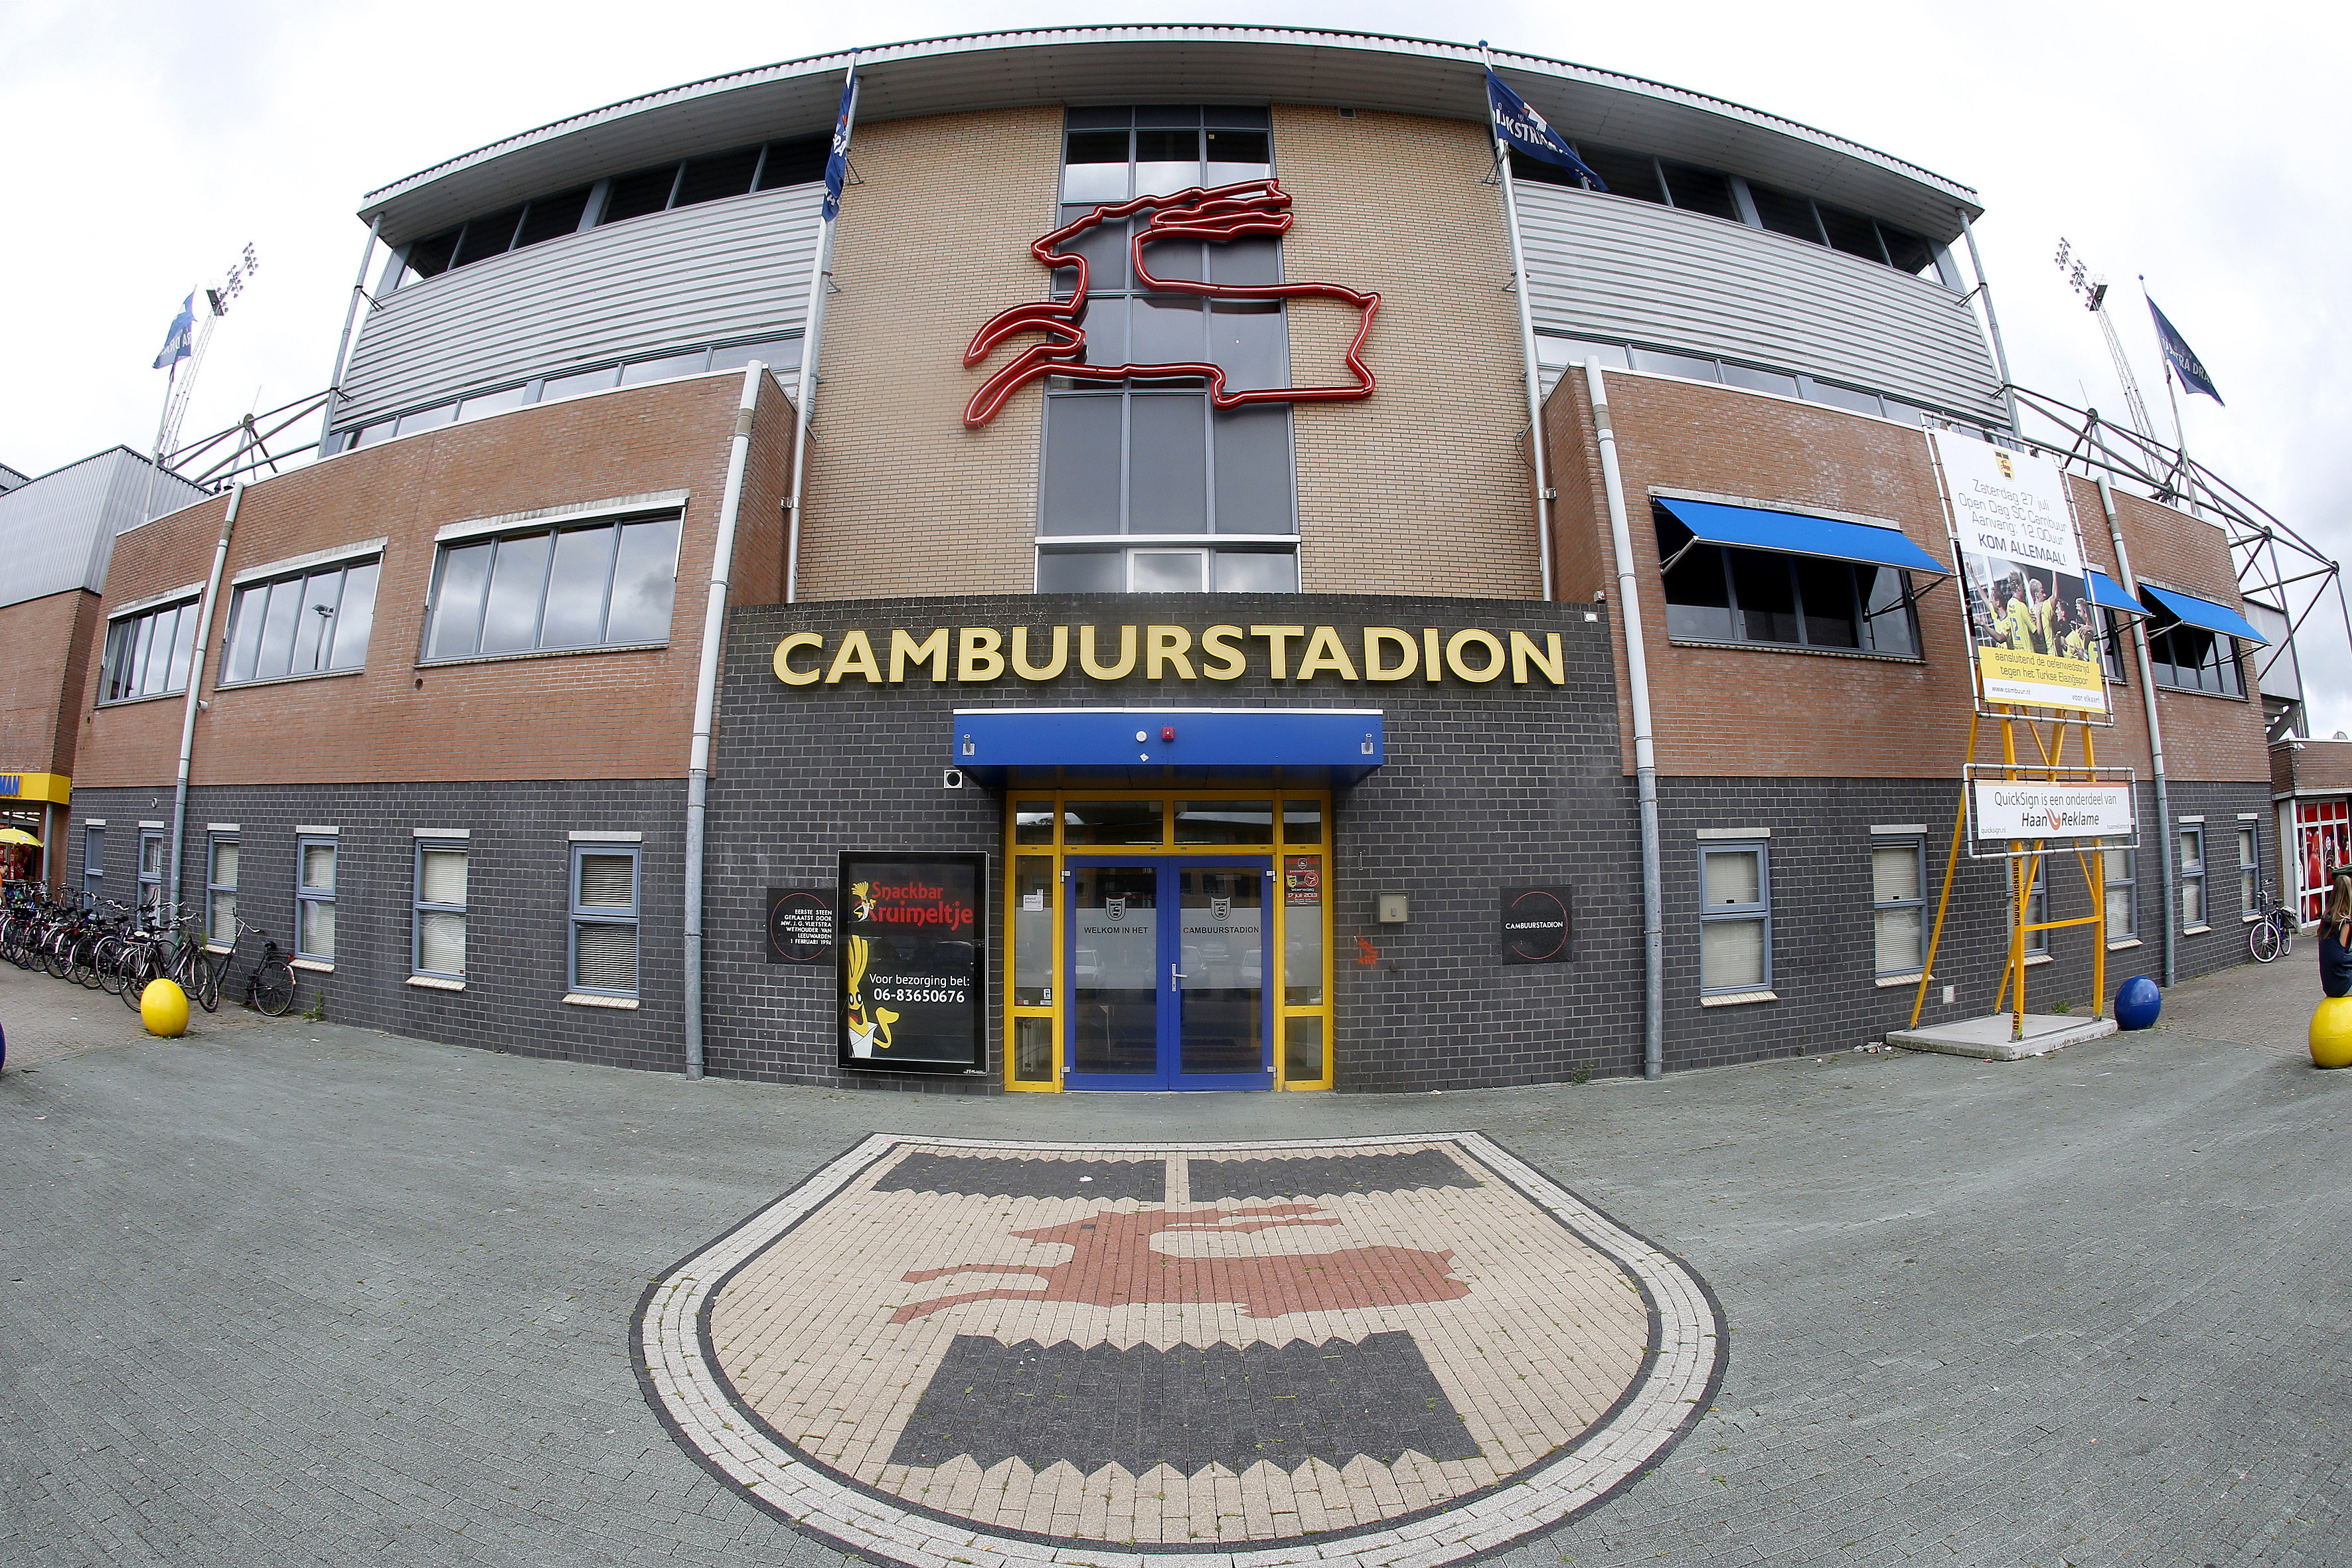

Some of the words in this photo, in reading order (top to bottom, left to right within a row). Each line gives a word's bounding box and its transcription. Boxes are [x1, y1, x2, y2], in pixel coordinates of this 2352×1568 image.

[1972, 479, 2019, 505] Zaterdag
[2021, 492, 2033, 506] 27
[2037, 497, 2049, 511] juli
[1958, 493, 1986, 510] Open
[1988, 500, 2010, 519] Dag
[2011, 506, 2026, 520] SC
[2028, 510, 2067, 532] Cambuur
[1972, 511, 2017, 536] Aanvang:
[2021, 523, 2064, 546] 12.00uur
[1978, 533, 2007, 552] KOM
[2011, 540, 2067, 566] ALLEMAAL!
[773, 626, 1565, 686] CAMBUURSTADION
[1995, 653, 2035, 665] aansluitend
[2037, 657, 2045, 666] de
[2047, 659, 2090, 675] oefenwedstrijd
[2000, 666, 2021, 678] tegen
[2023, 666, 2035, 678] het
[2035, 669, 2057, 681] Turkse
[1992, 686, 2031, 695] www.cambuur.nl
[1994, 791, 2039, 809] QuickSign
[2041, 793, 2047, 805] is
[2049, 796, 2063, 805] een
[2065, 792, 2103, 805] onderdeel
[2104, 795, 2117, 805] van
[2021, 812, 2047, 827] Haan
[2061, 811, 2099, 826] Reklame
[1981, 826, 2006, 835] quicksign.nl
[871, 881, 944, 901] Snackbar
[1505, 921, 1563, 929] CAMBUURSTADION
[869, 973, 893, 984] Voor
[896, 975, 947, 988] bezorging
[950, 976, 970, 986] bel:
[874, 988, 965, 1003] 06-83650676
